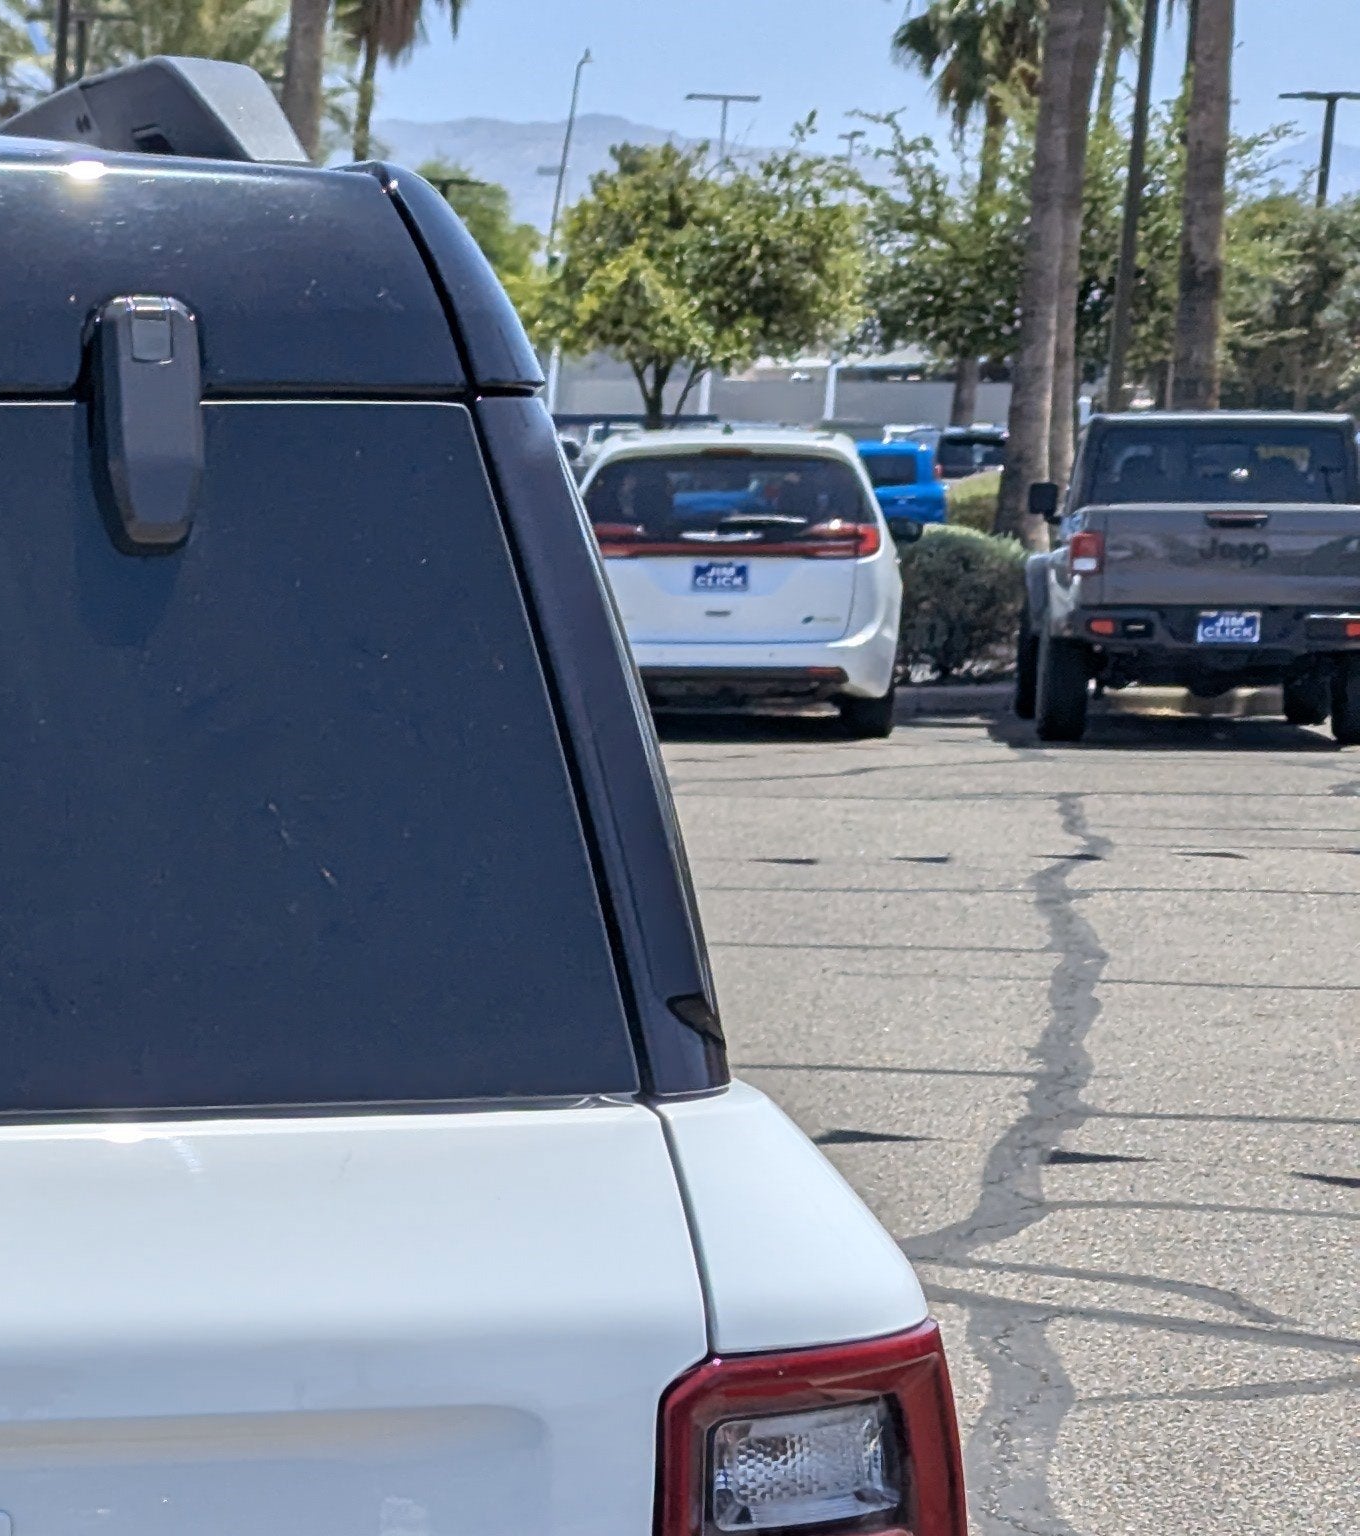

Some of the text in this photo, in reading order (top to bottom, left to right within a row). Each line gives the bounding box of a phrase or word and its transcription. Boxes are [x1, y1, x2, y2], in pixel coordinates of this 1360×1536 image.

[1199, 536, 1269, 568] Jeep
[707, 566, 736, 577] JIM
[696, 576, 743, 587] CLICK
[1214, 616, 1246, 627] JIM
[1203, 626, 1254, 637] CLICK
